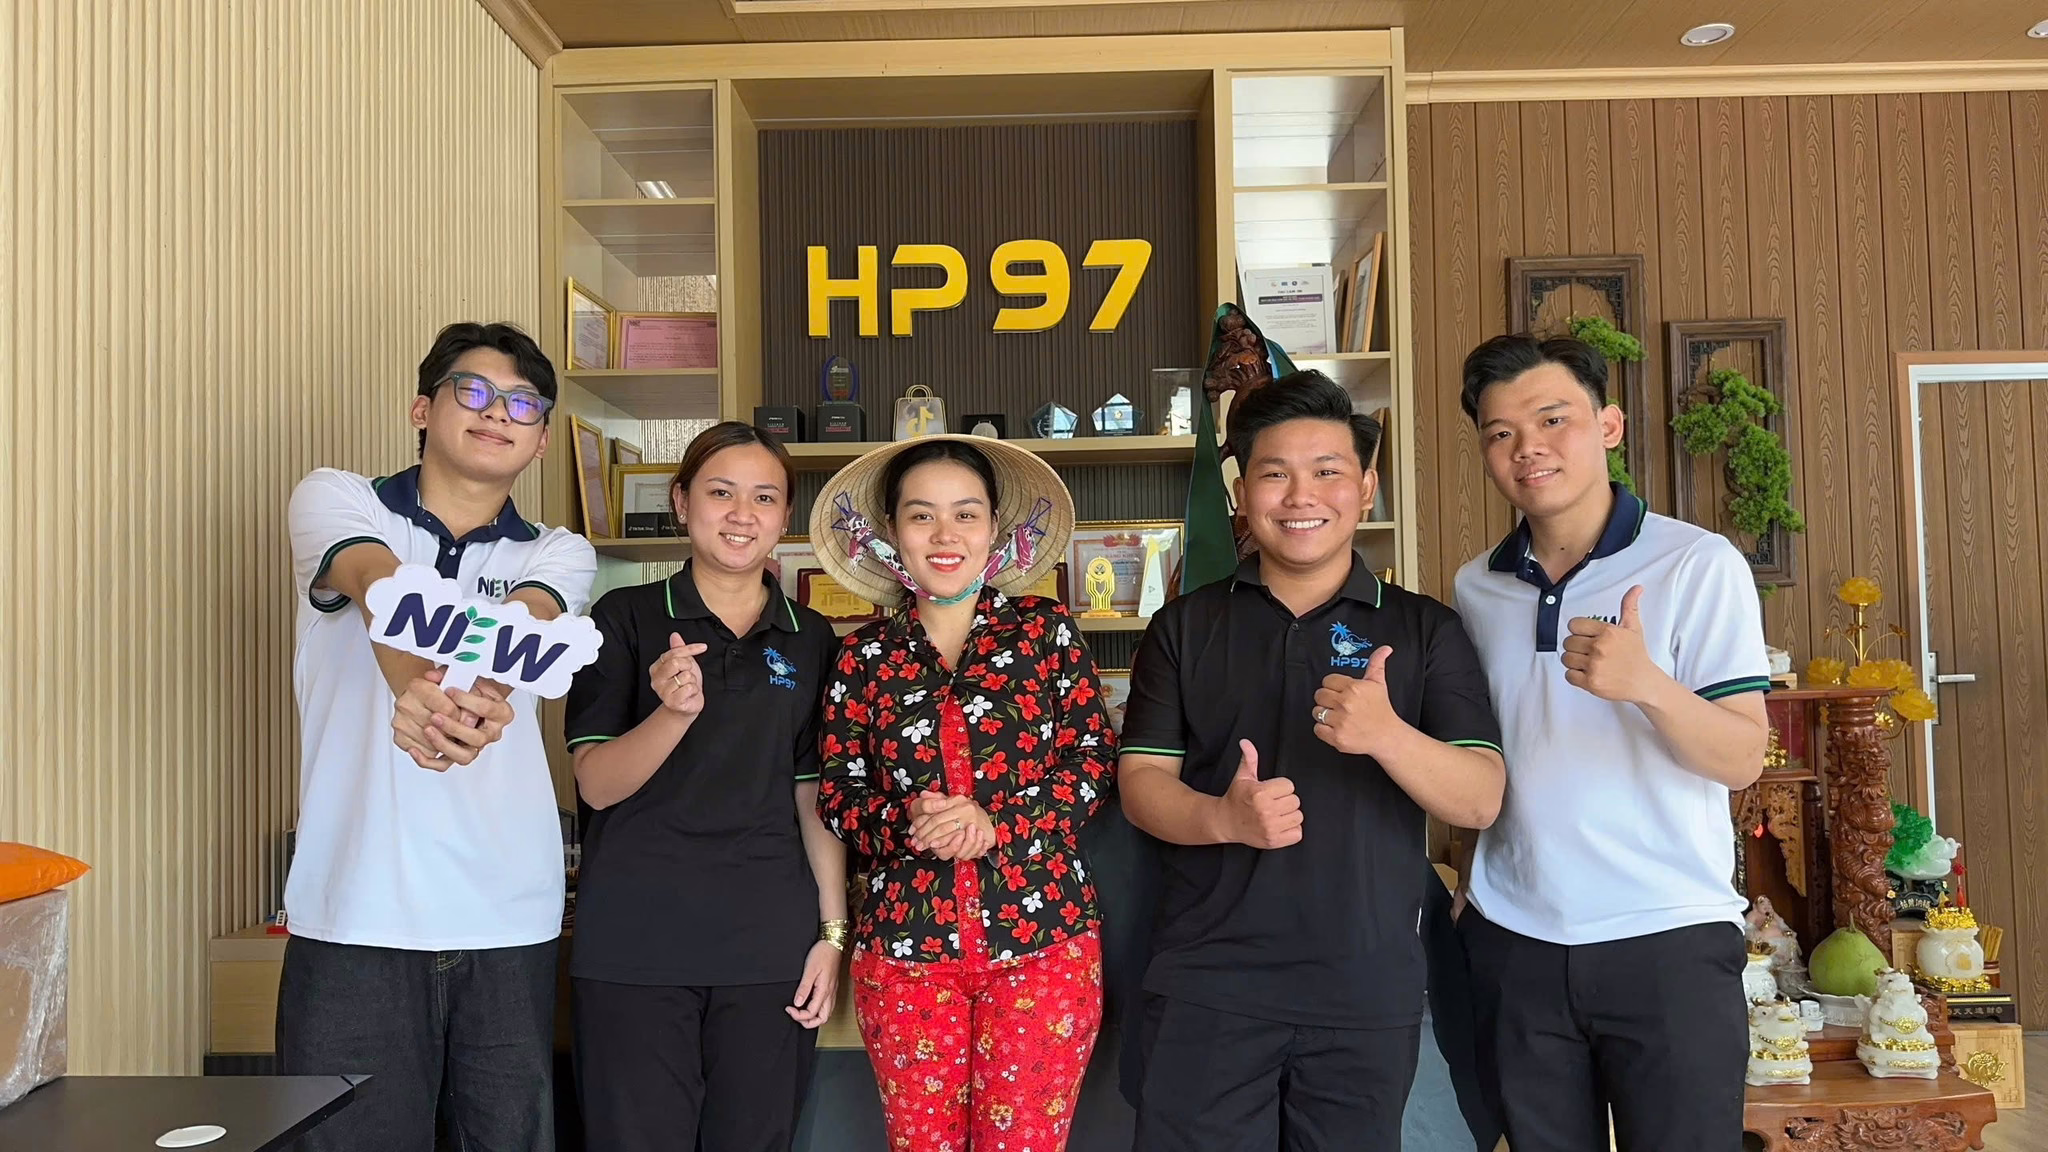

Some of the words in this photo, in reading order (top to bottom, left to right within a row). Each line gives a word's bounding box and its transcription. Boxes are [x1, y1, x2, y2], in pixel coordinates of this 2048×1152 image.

[383, 592, 570, 683] NEW
[1330, 656, 1369, 669] HP97
[769, 675, 796, 691] HP97
